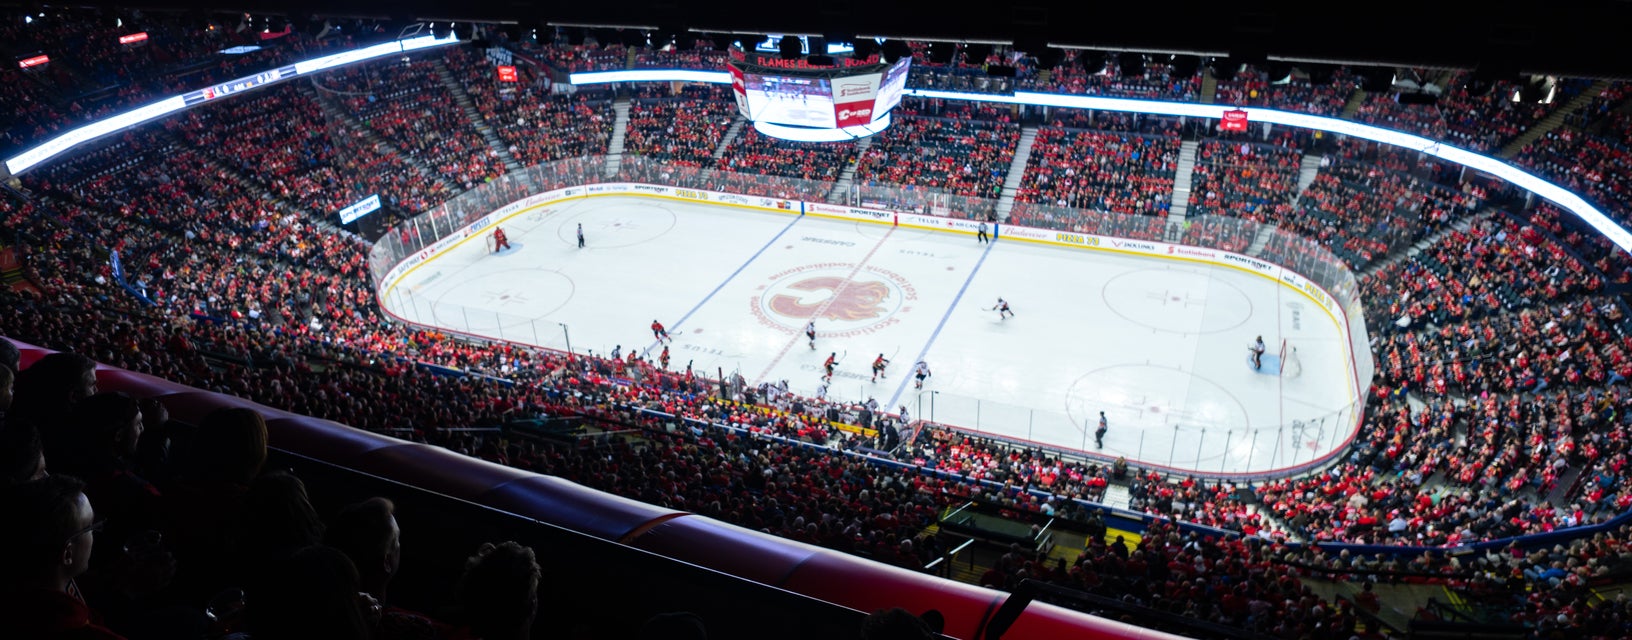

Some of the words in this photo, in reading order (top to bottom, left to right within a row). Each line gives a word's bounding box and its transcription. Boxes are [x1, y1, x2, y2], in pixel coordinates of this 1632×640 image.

[757, 56, 795, 69] FLAMES
[634, 185, 669, 193] SPORTSNET
[675, 189, 697, 199] PIZZA
[816, 205, 847, 214] Scotiabank
[850, 208, 890, 218] SPORTSNET
[917, 217, 939, 225] TELUS
[1004, 227, 1047, 239] Budweiser
[1056, 233, 1084, 245] PIZZA
[1087, 235, 1100, 246] 73
[1177, 248, 1216, 259] Scotiabank
[1224, 254, 1272, 269] SPORTSNET
[816, 316, 901, 338] Scotiaban
